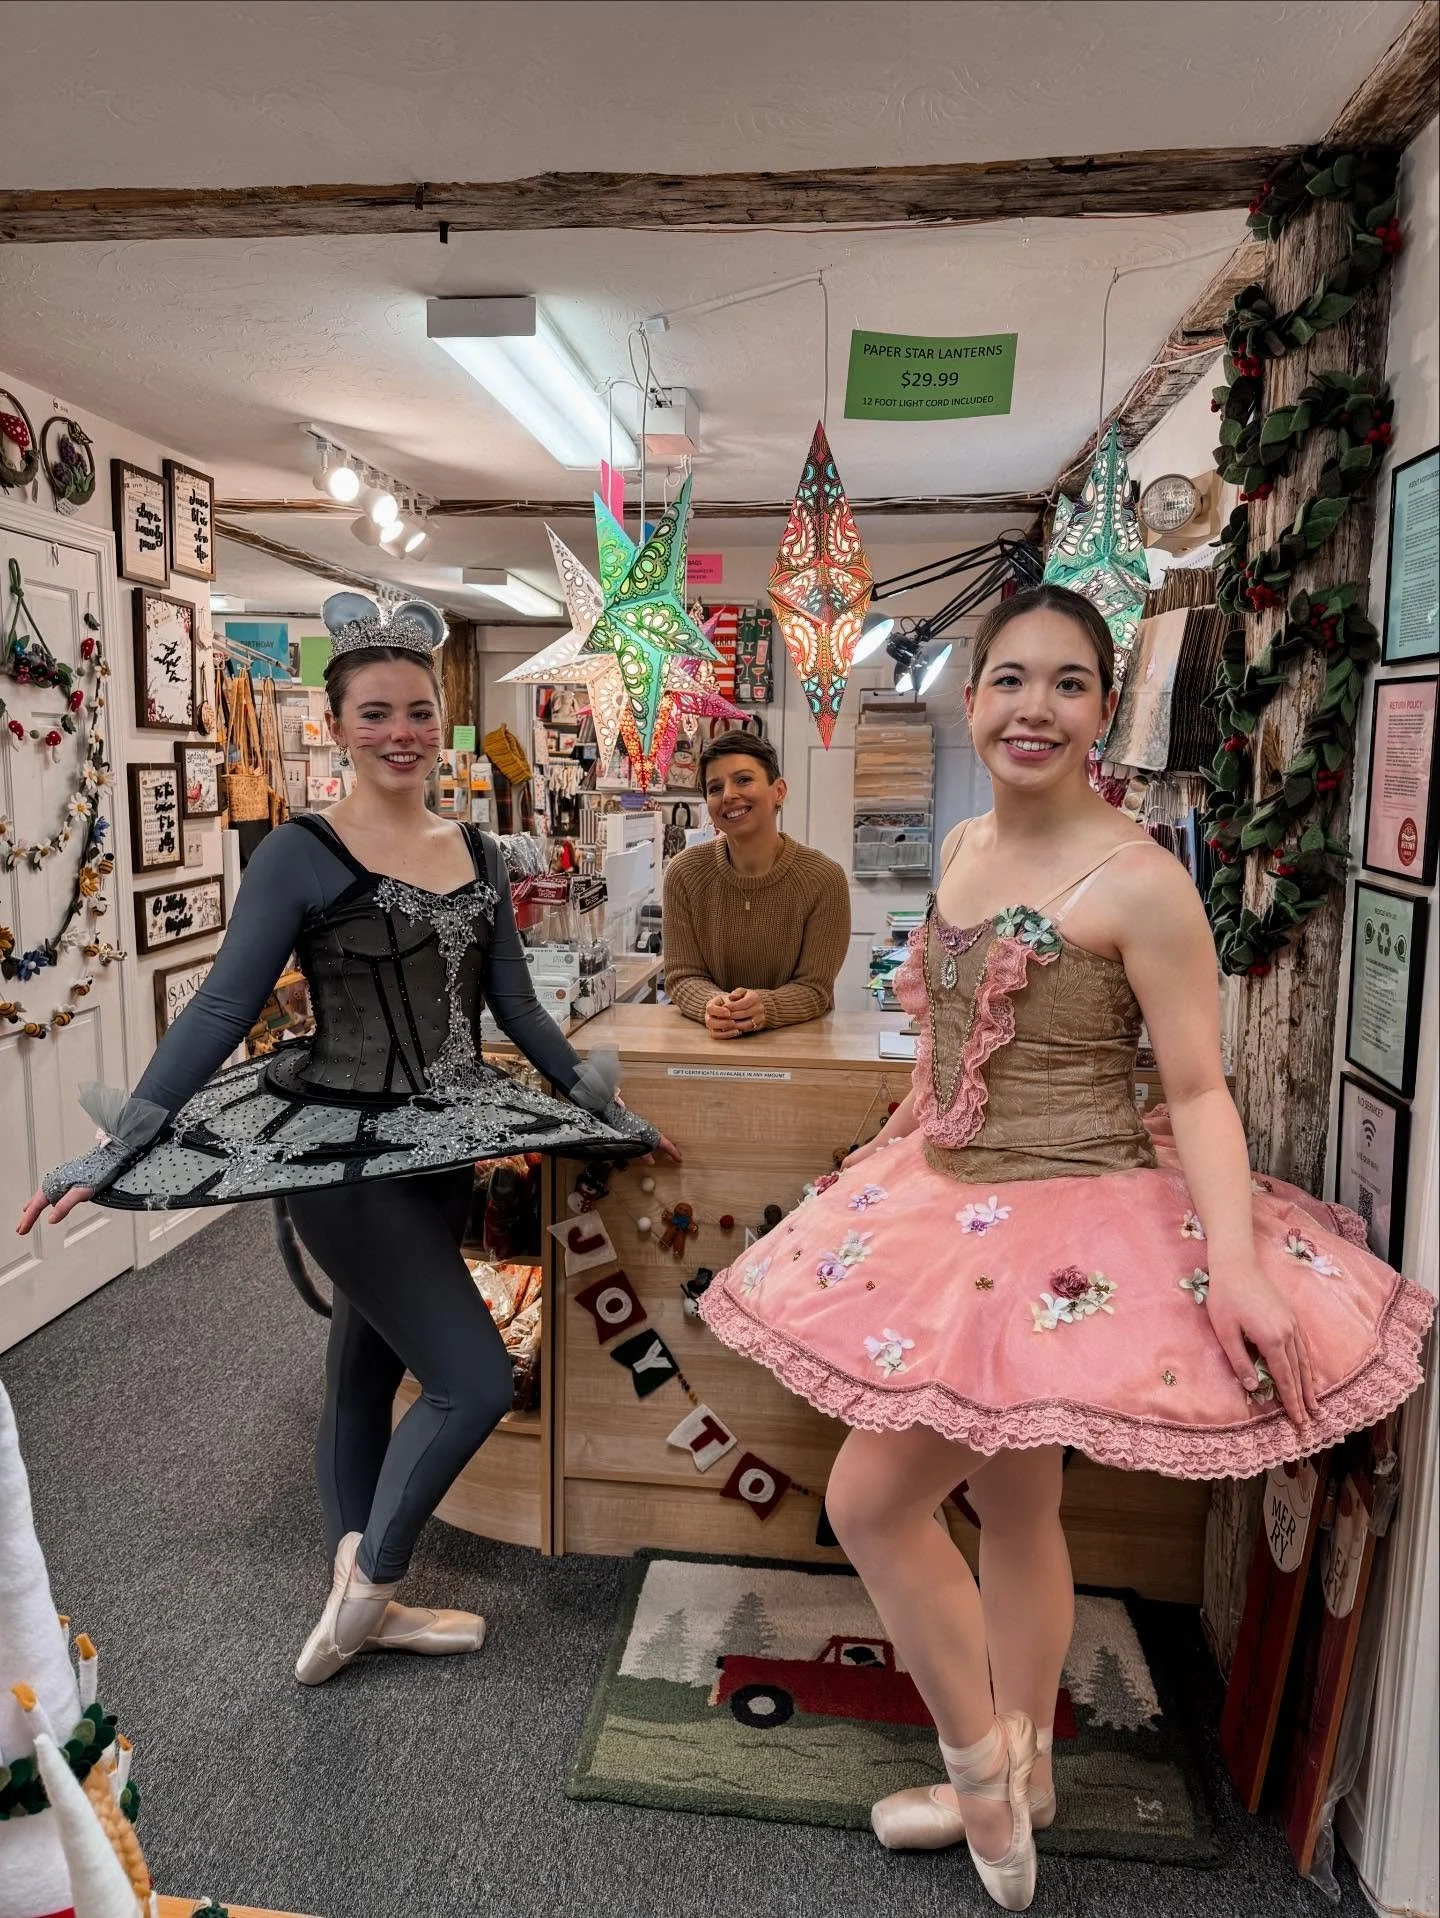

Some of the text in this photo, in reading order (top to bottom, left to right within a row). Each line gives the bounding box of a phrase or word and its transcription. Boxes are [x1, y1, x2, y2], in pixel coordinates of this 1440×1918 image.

[863, 343, 1003, 360] PAPER STAR LANTERNS
[901, 370, 959, 389] $29.99
[863, 396, 994, 407] 12 FOOT LIGHT CORD INCLUDED
[152, 893, 187, 917] O Holy
[1357, 1096, 1384, 1118] NO SERVICE?
